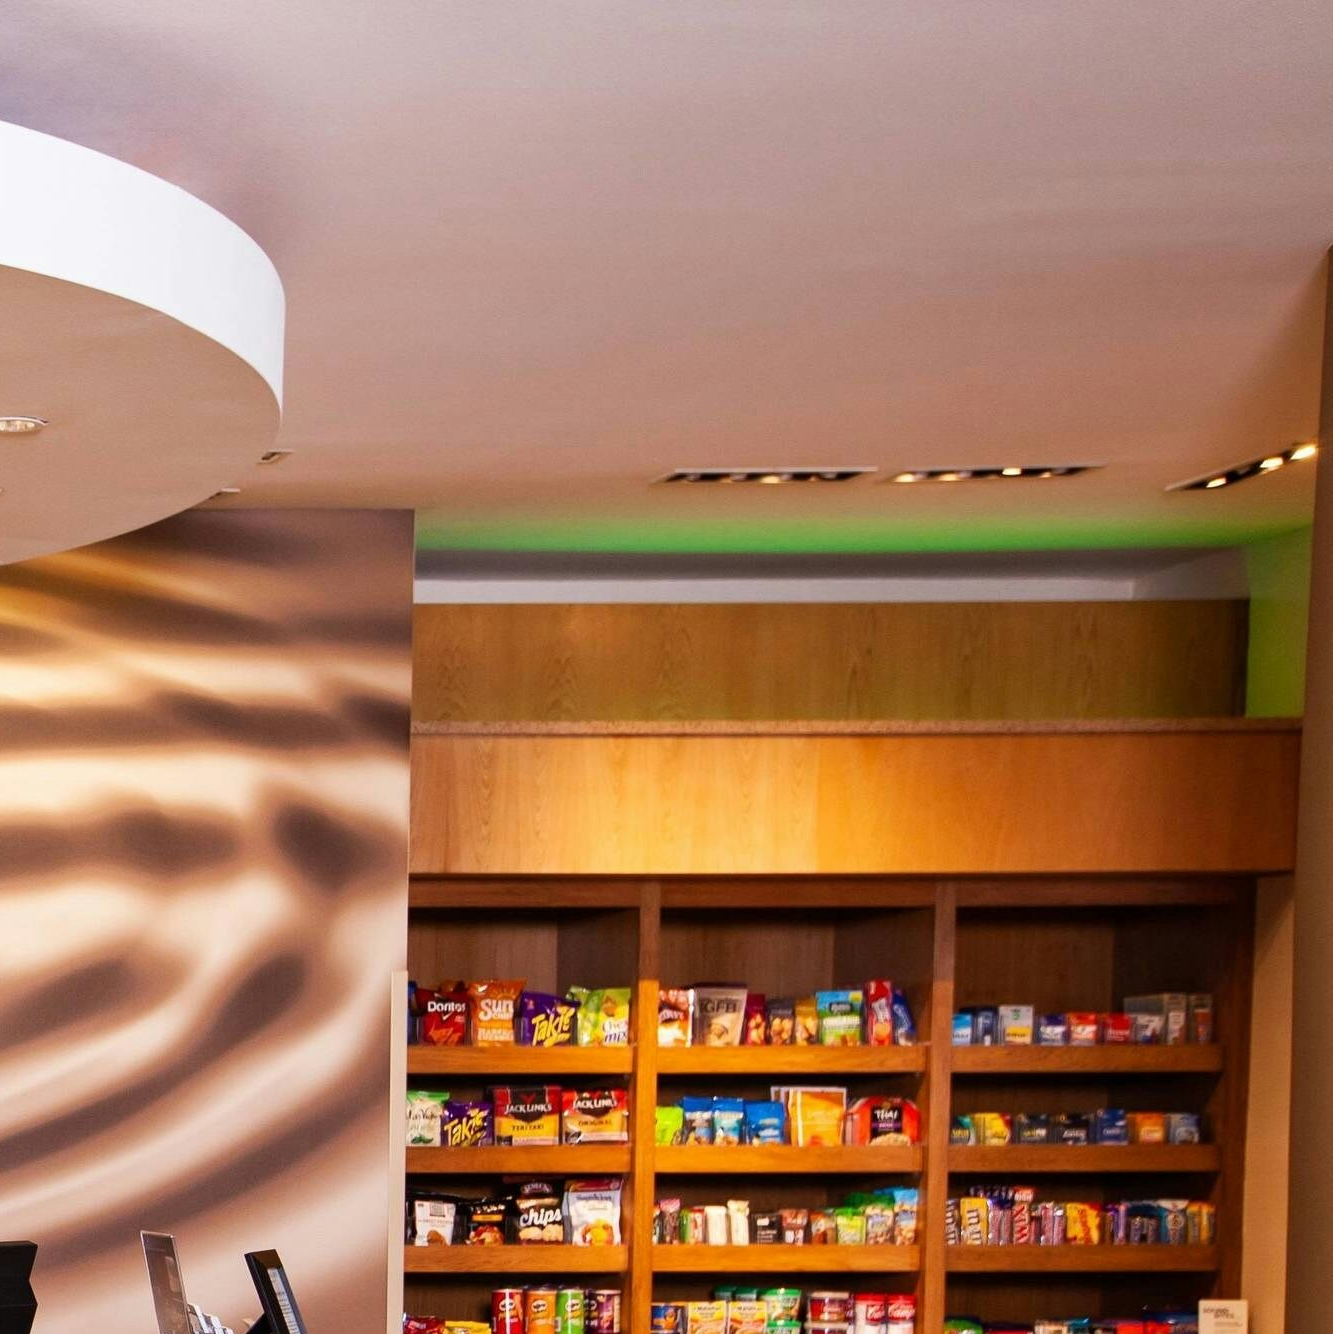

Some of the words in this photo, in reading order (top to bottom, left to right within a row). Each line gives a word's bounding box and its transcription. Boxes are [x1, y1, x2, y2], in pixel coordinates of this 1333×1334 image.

[427, 1001, 466, 1013] Doritos
[478, 998, 514, 1022] Sun
[519, 1208, 562, 1228] chips
